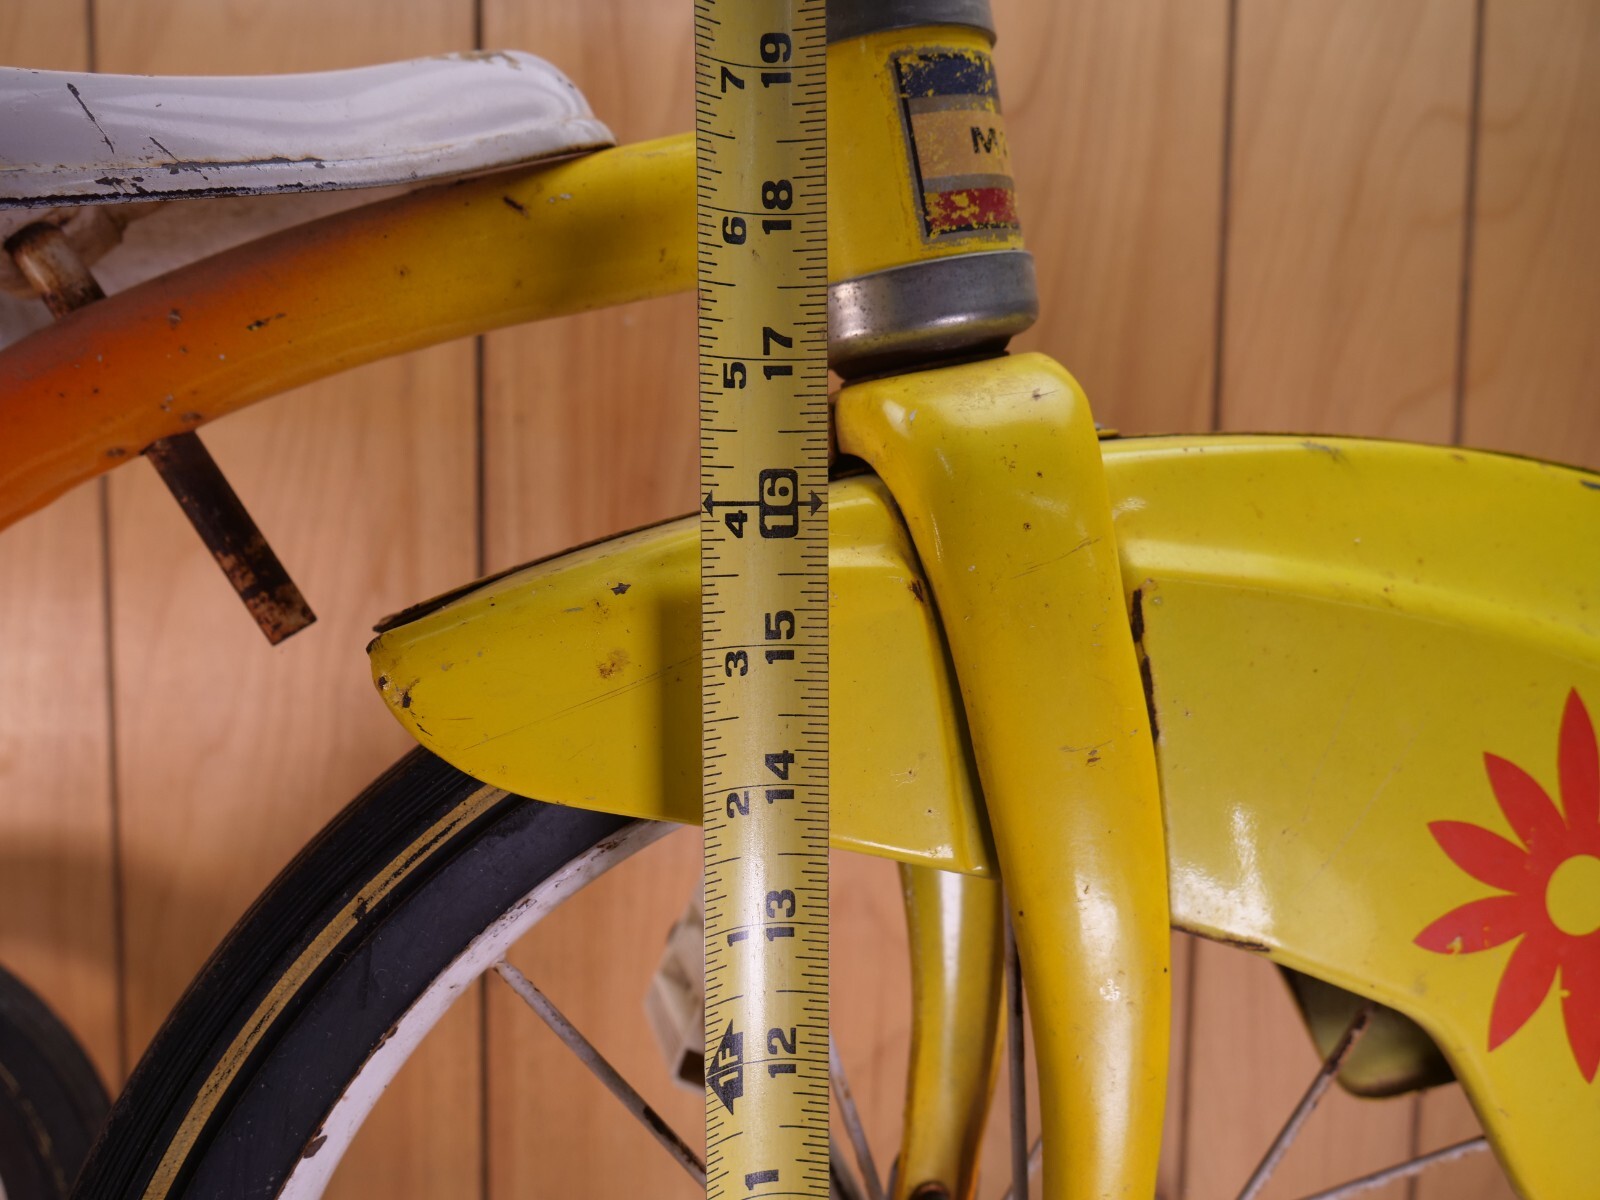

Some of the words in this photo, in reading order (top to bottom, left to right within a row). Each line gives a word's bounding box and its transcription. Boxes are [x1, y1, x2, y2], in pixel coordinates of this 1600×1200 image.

[720, 65, 745, 93] 7
[760, 32, 792, 88] 19
[970, 126, 1007, 157] M
[761, 179, 793, 235] 18
[722, 216, 747, 245] 6
[762, 326, 793, 380] 17
[722, 361, 747, 389] 5
[724, 510, 748, 538] 4
[762, 475, 795, 533] 16
[764, 610, 795, 664] 15
[724, 650, 749, 677] 3
[764, 749, 795, 804] 14
[726, 790, 750, 818] 2
[765, 889, 796, 941] 13
[726, 930, 750, 947] 1
[718, 1046, 740, 1089] 1F
[766, 1027, 797, 1078] 12
